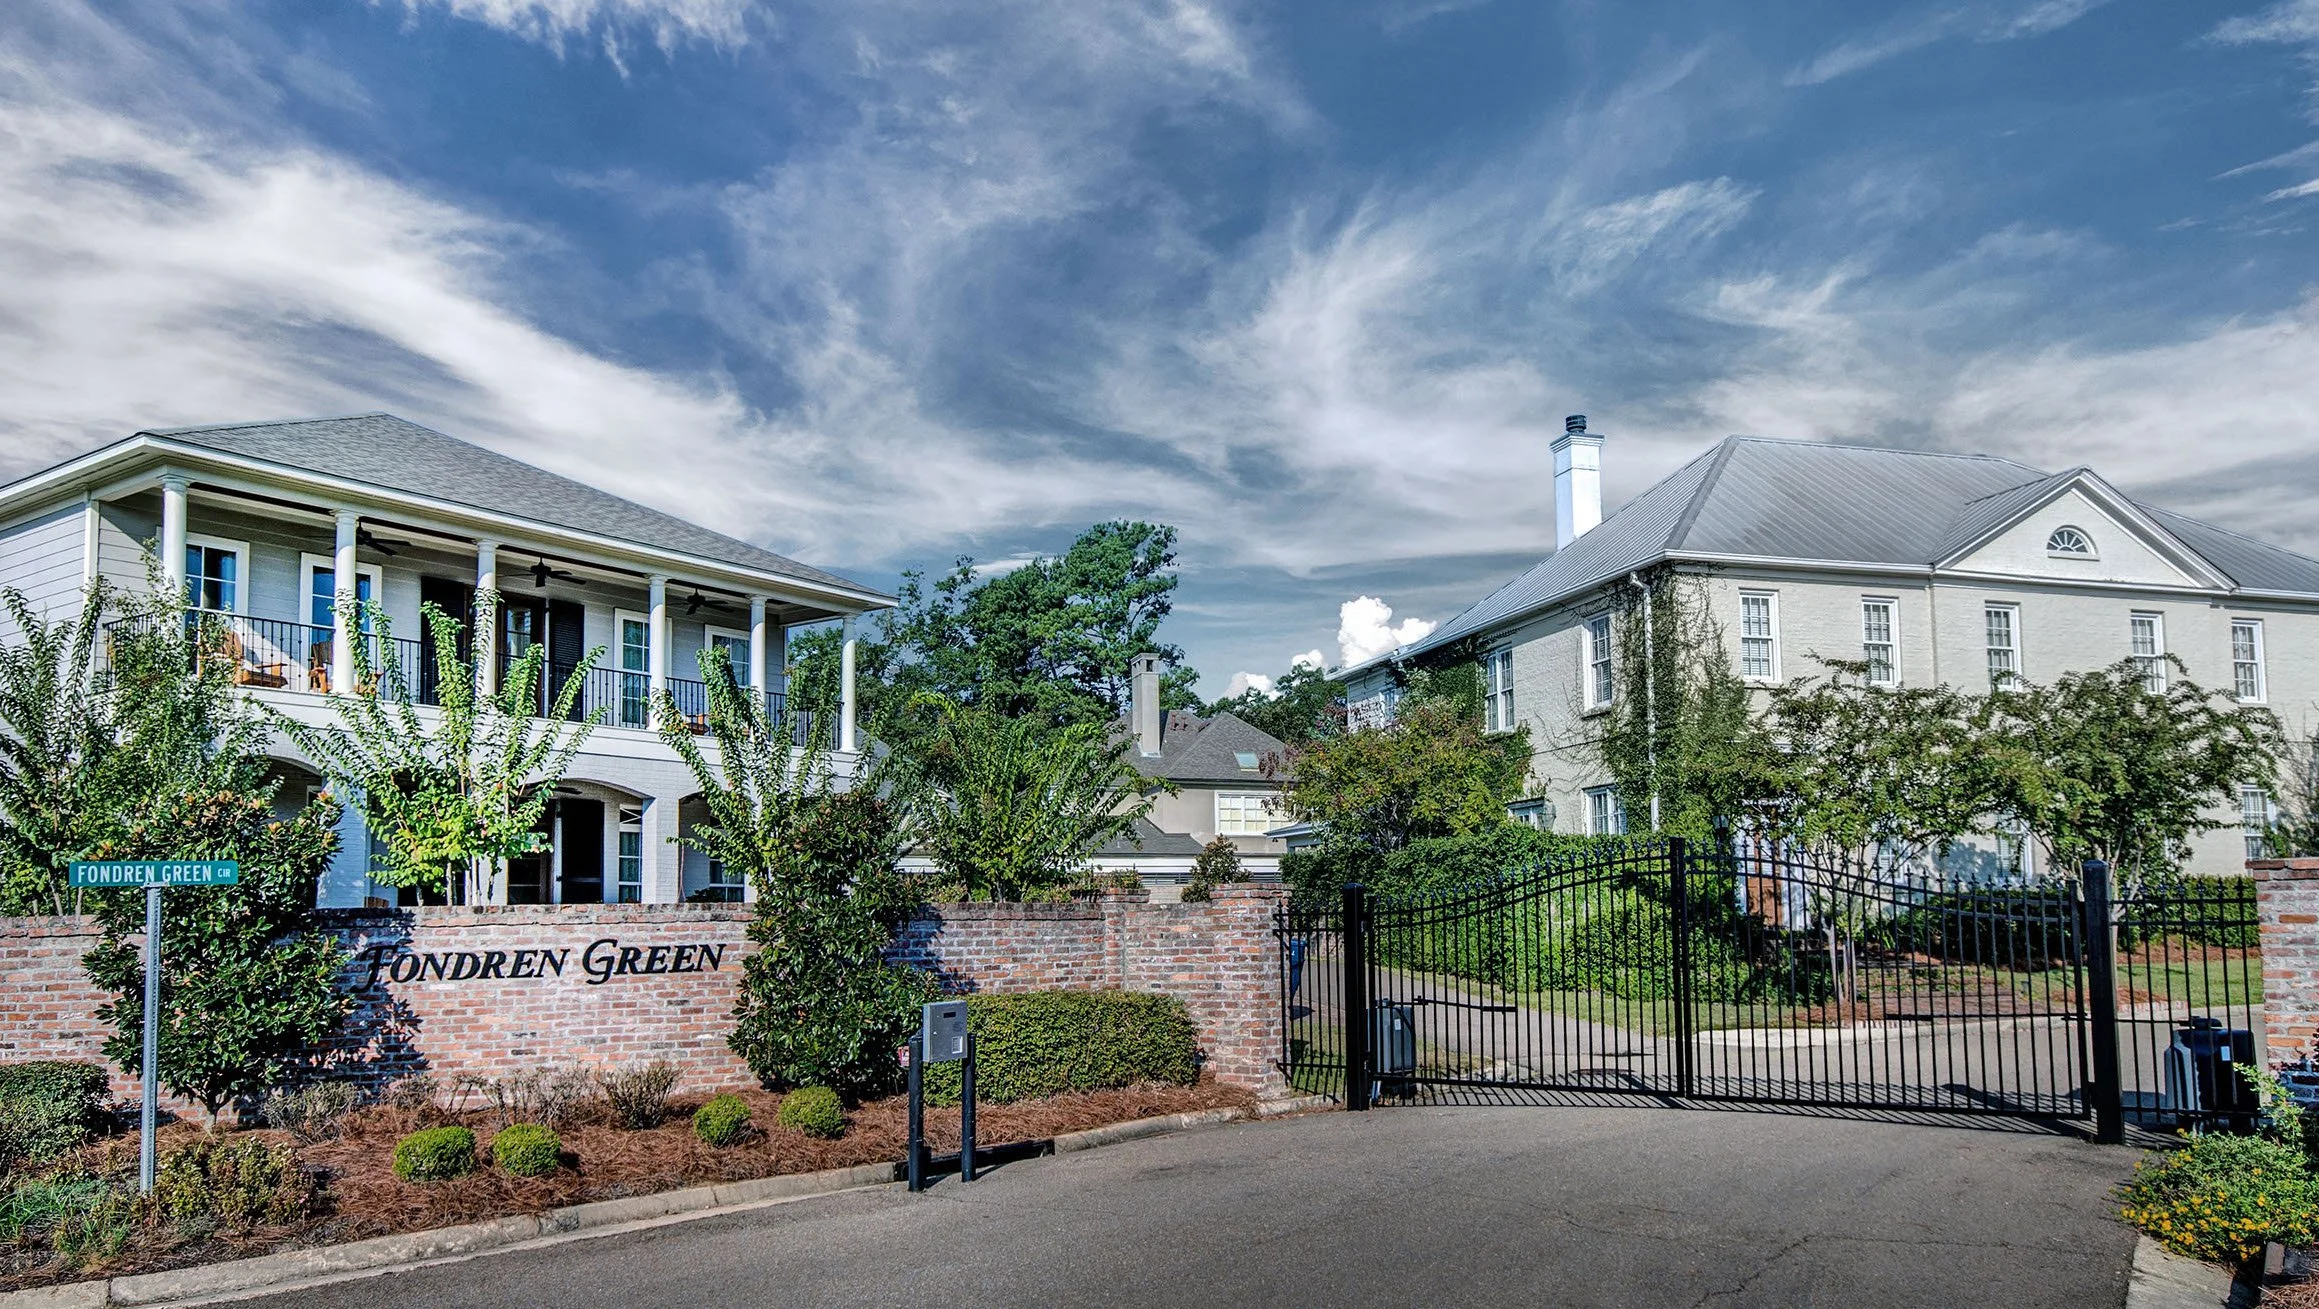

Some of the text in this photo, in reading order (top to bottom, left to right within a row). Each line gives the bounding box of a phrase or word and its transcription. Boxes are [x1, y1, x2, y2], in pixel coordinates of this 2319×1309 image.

[77, 865, 231, 883] FONDREN GREEN CIR
[349, 938, 727, 993] FONDREN GREEN
